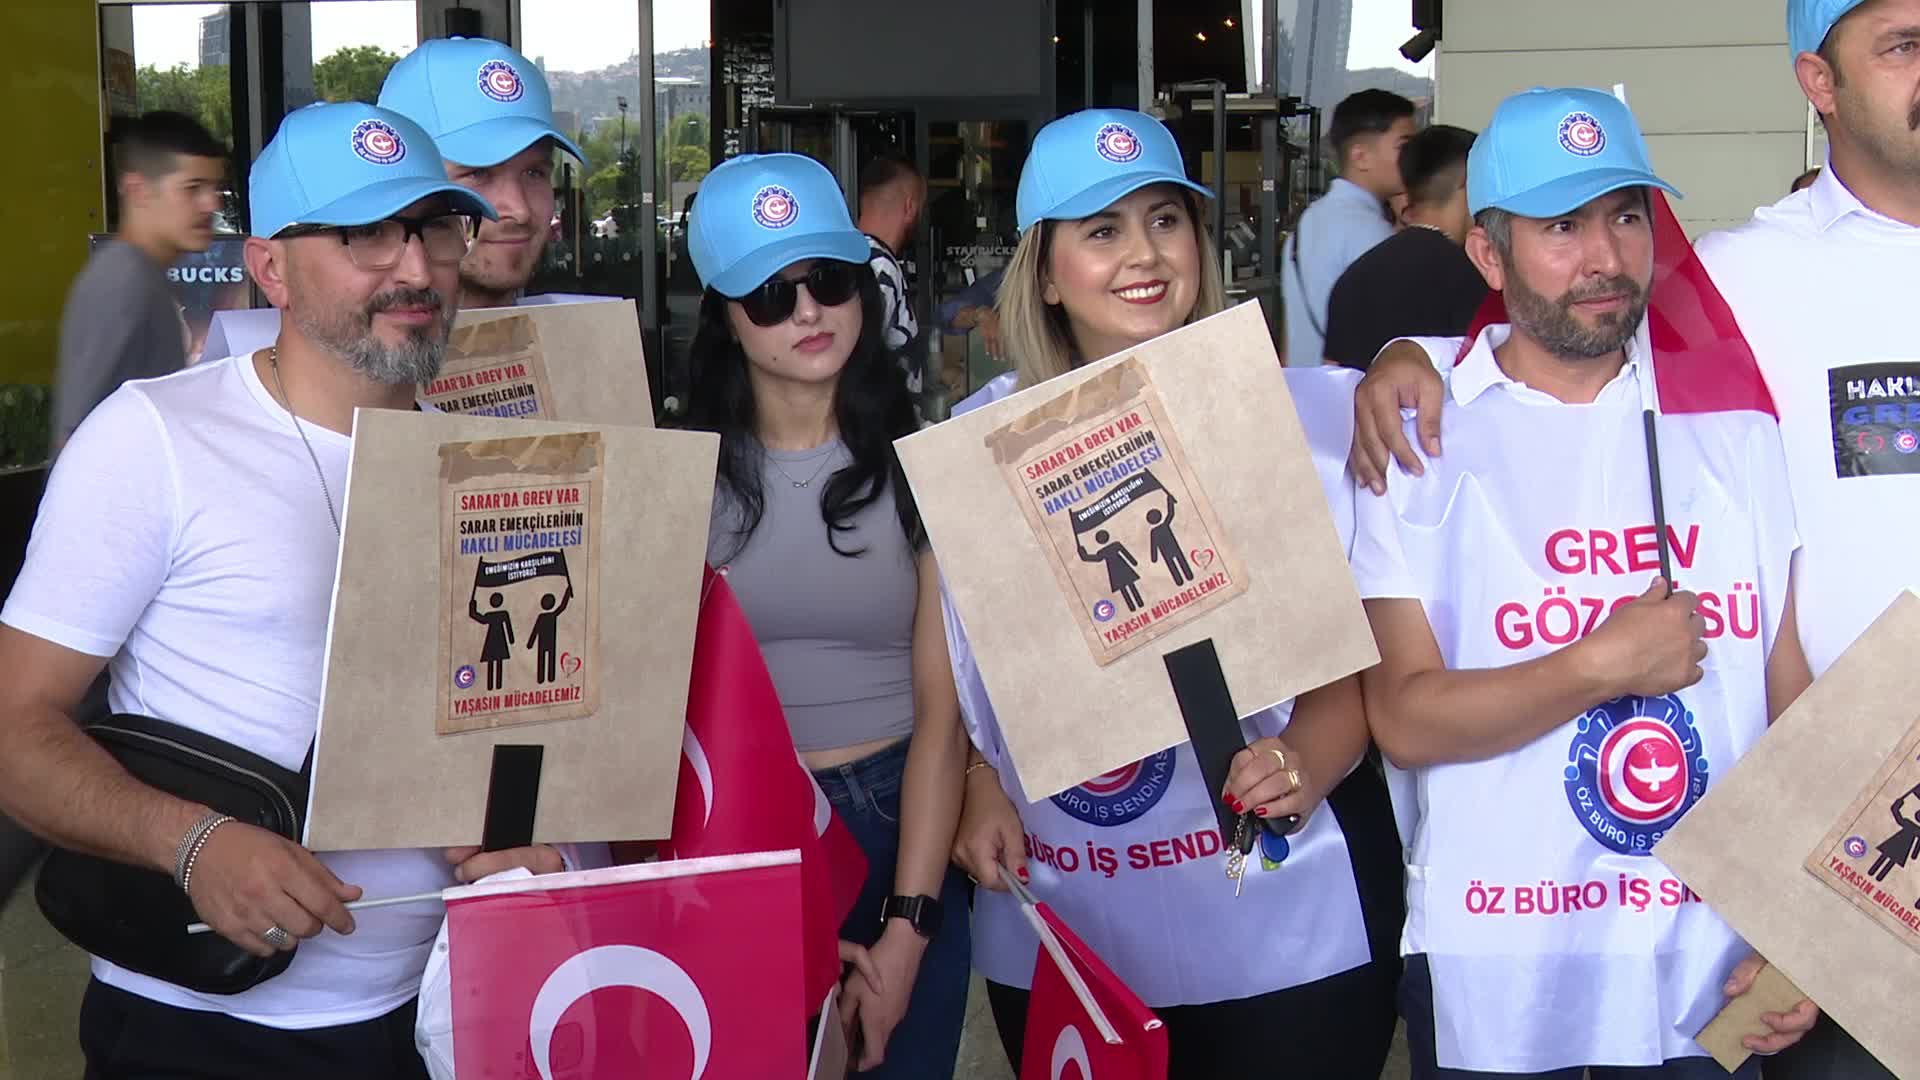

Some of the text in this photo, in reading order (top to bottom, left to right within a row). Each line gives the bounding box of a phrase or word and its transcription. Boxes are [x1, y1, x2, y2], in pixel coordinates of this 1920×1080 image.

[475, 367, 503, 385] GREV
[504, 363, 526, 380] VAR
[462, 382, 535, 409] EMEKÇİLERİNİN
[1026, 412, 1142, 480] SARAR'DA GREV VAR
[1036, 429, 1156, 499] SARAR EMEKÇİLERİNİN
[461, 488, 579, 511] SARAR'DA GREV VAR
[1044, 444, 1162, 516] HAKLI MÜCADELESİ
[460, 510, 583, 535] SARAR EMEKÇİLERİNİN
[461, 527, 582, 555] HAKLI MÜCADELESİ
[1545, 525, 1699, 575] GREV
[1104, 612, 1151, 644] YAŞASIN
[1151, 572, 1227, 619] MÜCADELEMİZ
[1495, 582, 1759, 650] GÖZSÜ
[454, 684, 580, 716] YAŞASIN MÜCADELEMİZ
[1576, 786, 1593, 811] ÖZ
[1589, 811, 1626, 845] BÜRO
[1086, 841, 1118, 878] İŞ
[1829, 856, 1874, 895] YAŞASIN
[1465, 880, 1506, 914] ÖZ
[1514, 880, 1608, 915] BÜRO
[1619, 873, 1652, 913] İŞ
